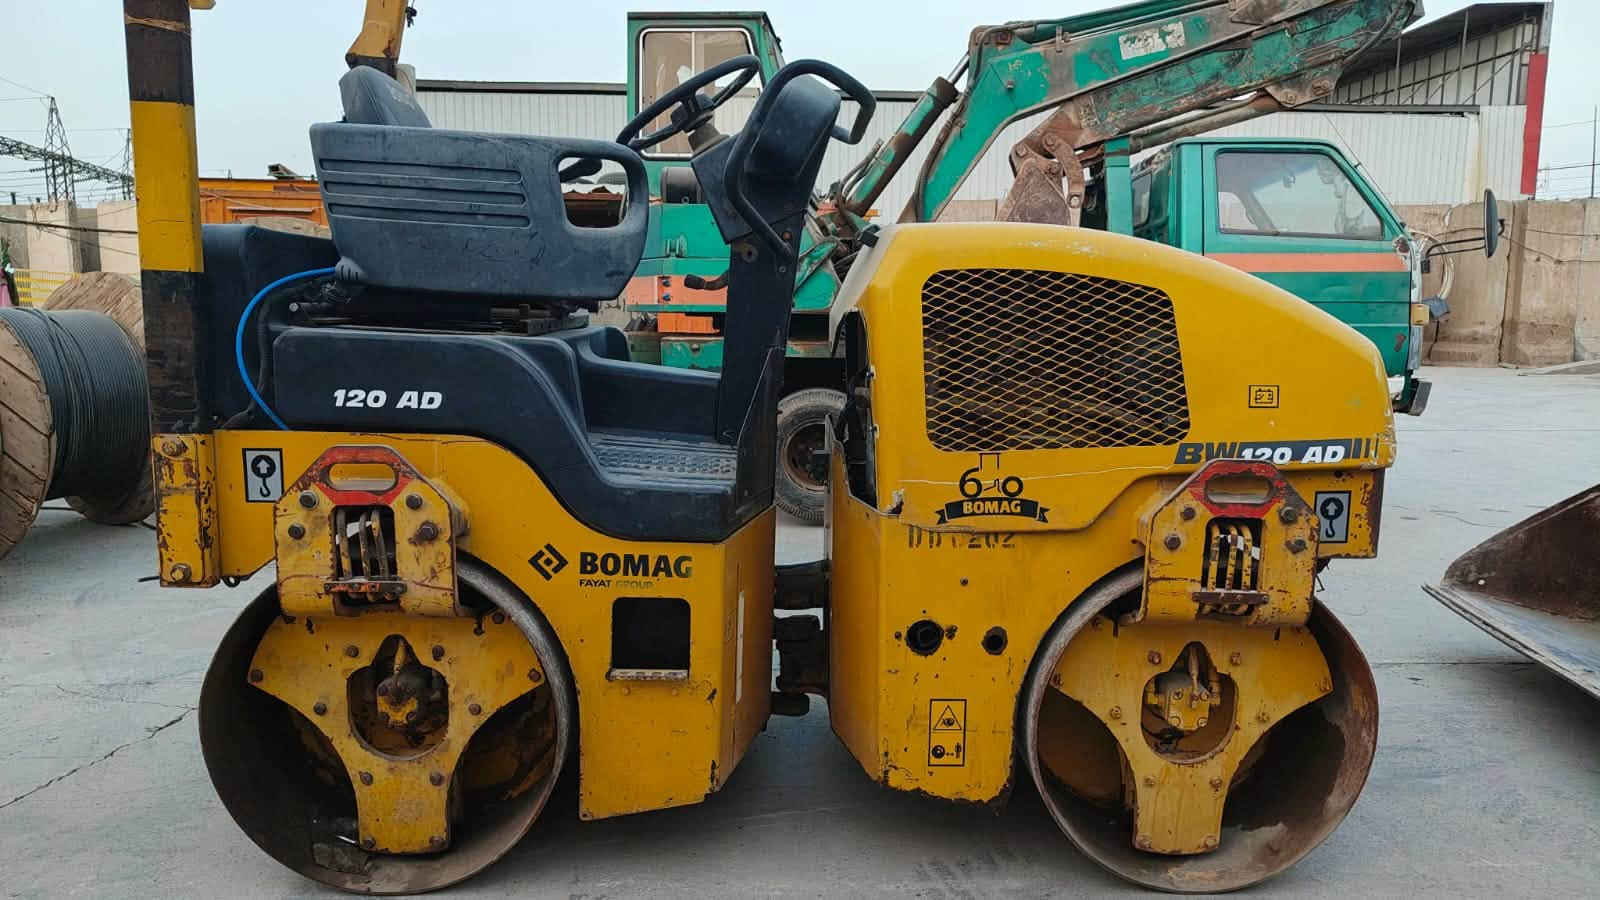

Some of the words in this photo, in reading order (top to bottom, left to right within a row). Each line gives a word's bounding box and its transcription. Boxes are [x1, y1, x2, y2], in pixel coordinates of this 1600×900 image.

[334, 389, 387, 408] 120
[395, 390, 442, 409] AD
[1300, 445, 1346, 464] AD
[962, 500, 1021, 514] BOMAG
[579, 551, 692, 579] BOMAG
[579, 579, 611, 588] FAYAT
